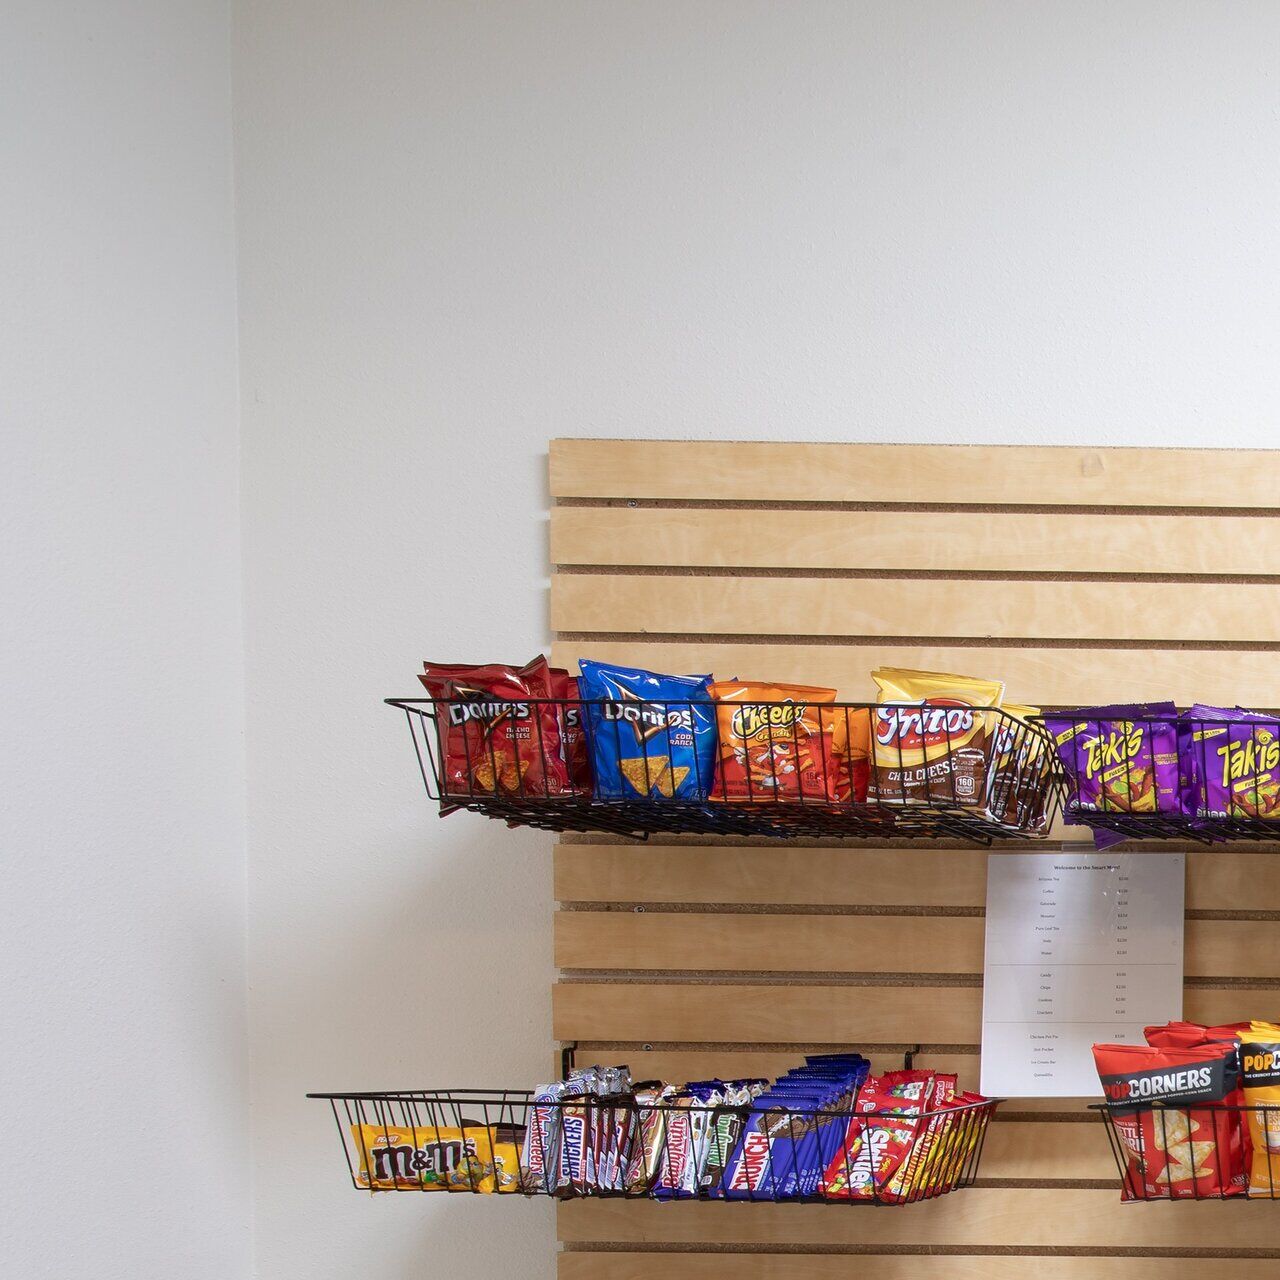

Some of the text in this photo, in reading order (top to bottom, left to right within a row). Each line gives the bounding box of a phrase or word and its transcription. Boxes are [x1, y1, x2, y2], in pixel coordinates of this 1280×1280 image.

[605, 701, 693, 726] Doritos
[877, 699, 974, 745] Fritos
[1083, 722, 1144, 780] Takis
[1217, 731, 1280, 787] Takis
[958, 778, 974, 786] 160
